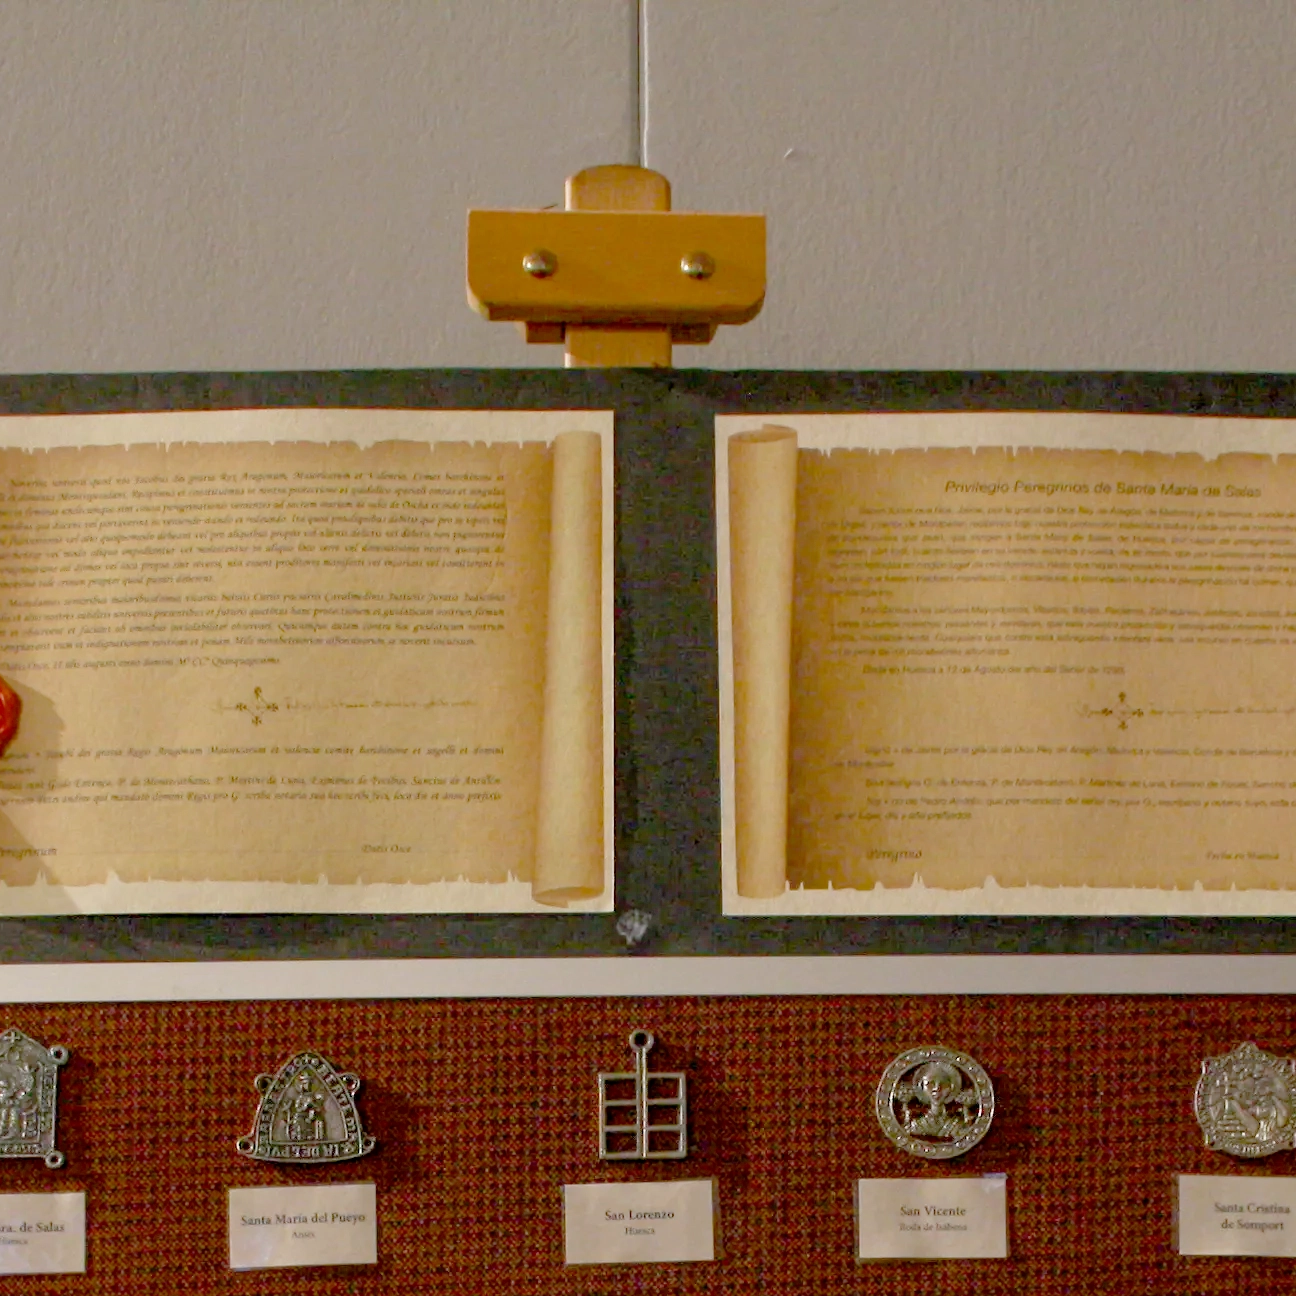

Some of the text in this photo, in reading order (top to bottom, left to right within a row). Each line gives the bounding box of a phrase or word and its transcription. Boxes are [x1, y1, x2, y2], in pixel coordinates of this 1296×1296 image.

[605, 1209, 674, 1220] San Lorenzo
[900, 1205, 966, 1216] San Vicente
[241, 1212, 365, 1225] Santa María del Pueyo
